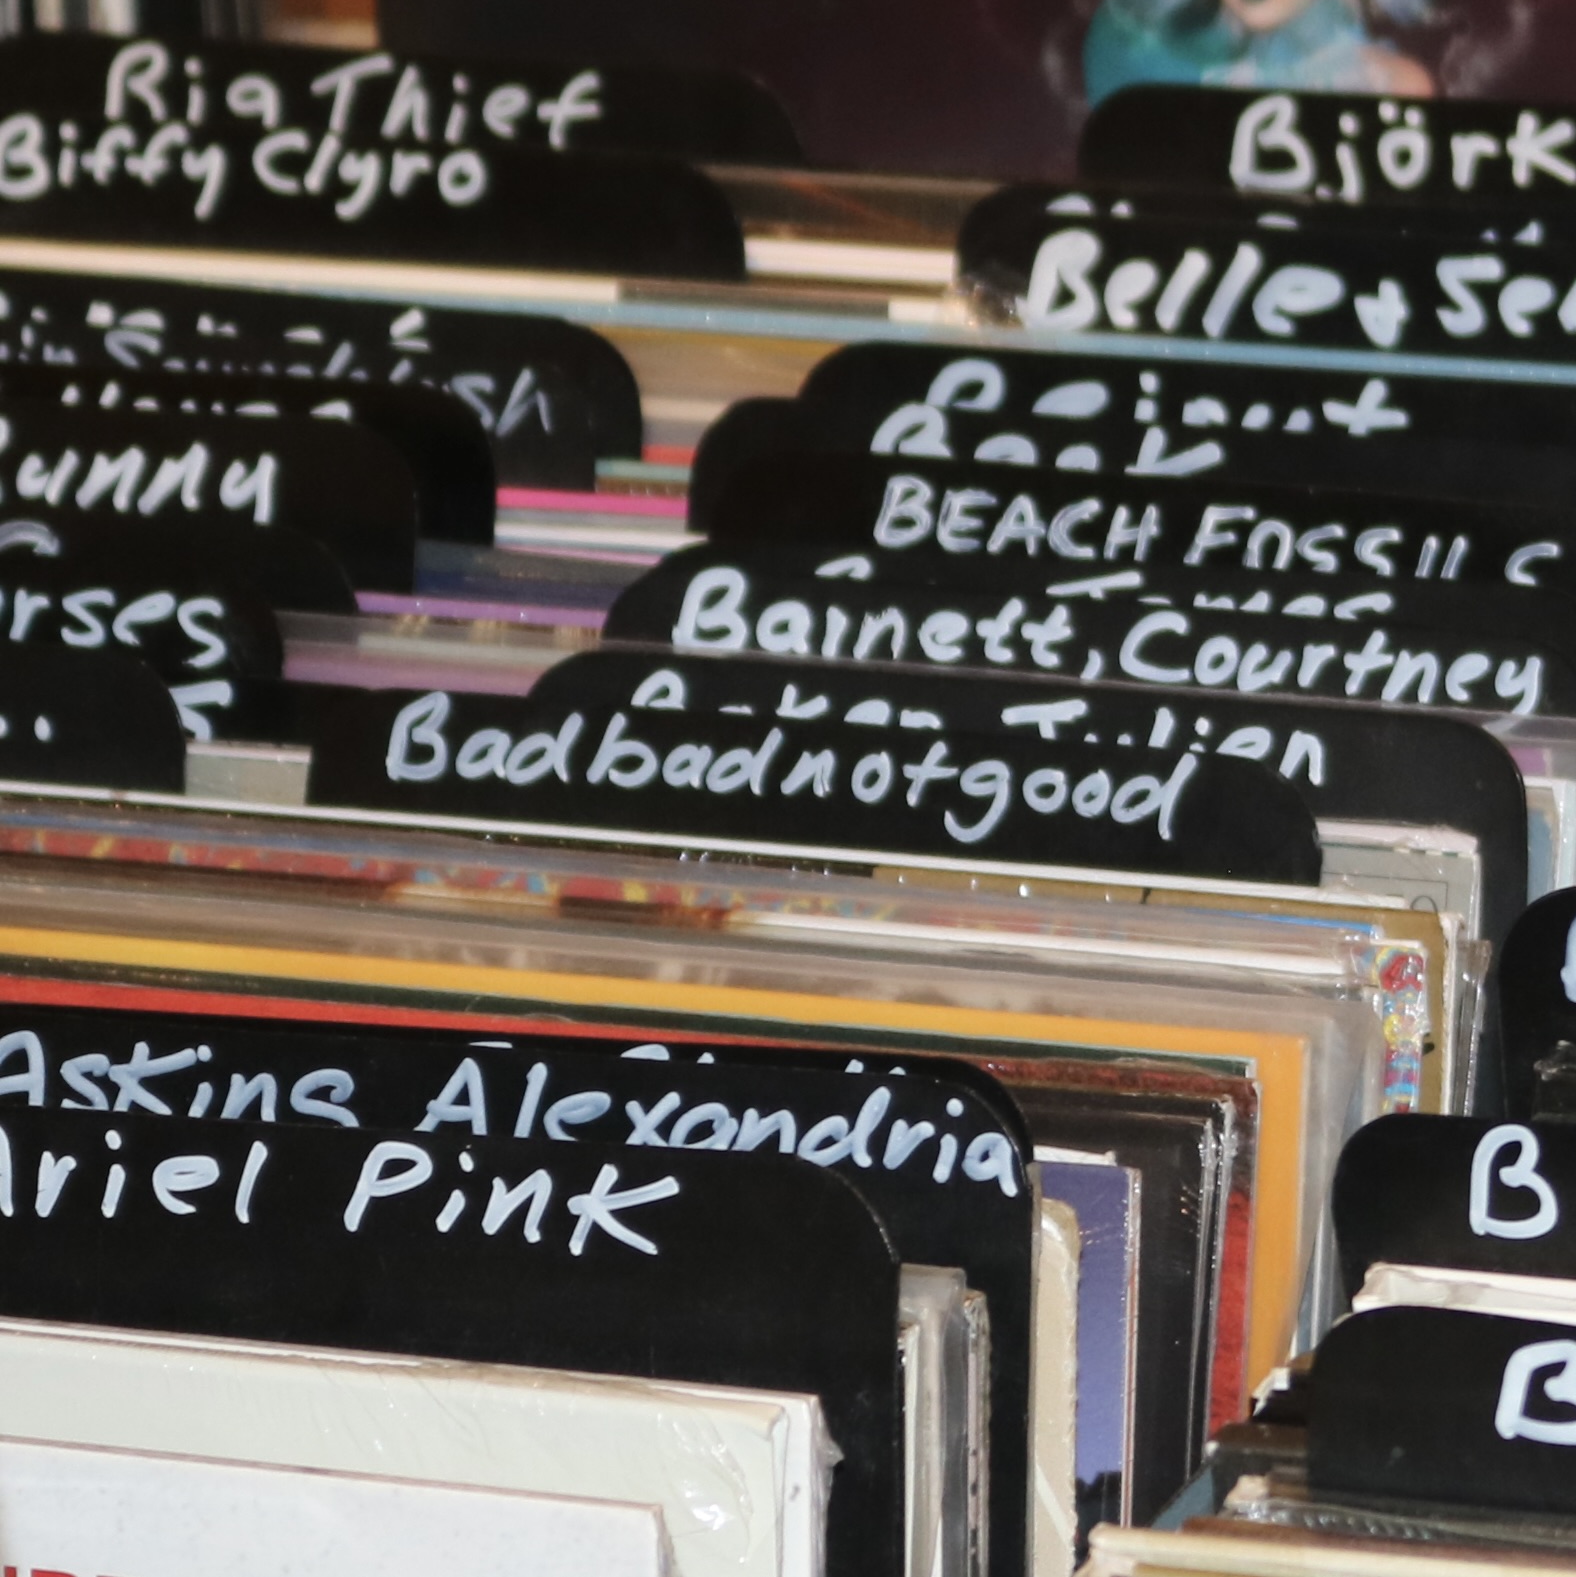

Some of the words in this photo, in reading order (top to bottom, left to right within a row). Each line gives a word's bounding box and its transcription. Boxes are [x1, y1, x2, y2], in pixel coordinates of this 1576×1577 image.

[311, 52, 602, 151] Thief
[0, 115, 226, 221] Biffy
[253, 130, 489, 221] Clyro
[1016, 227, 1344, 337] Belle
[872, 473, 1161, 563] BEACH
[0, 587, 228, 670] rses
[1120, 611, 1542, 716] Courtney
[385, 690, 1200, 844] Badbadnotgood
[413, 1056, 1021, 1199] Alexandria
[343, 1138, 681, 1257] Pink
